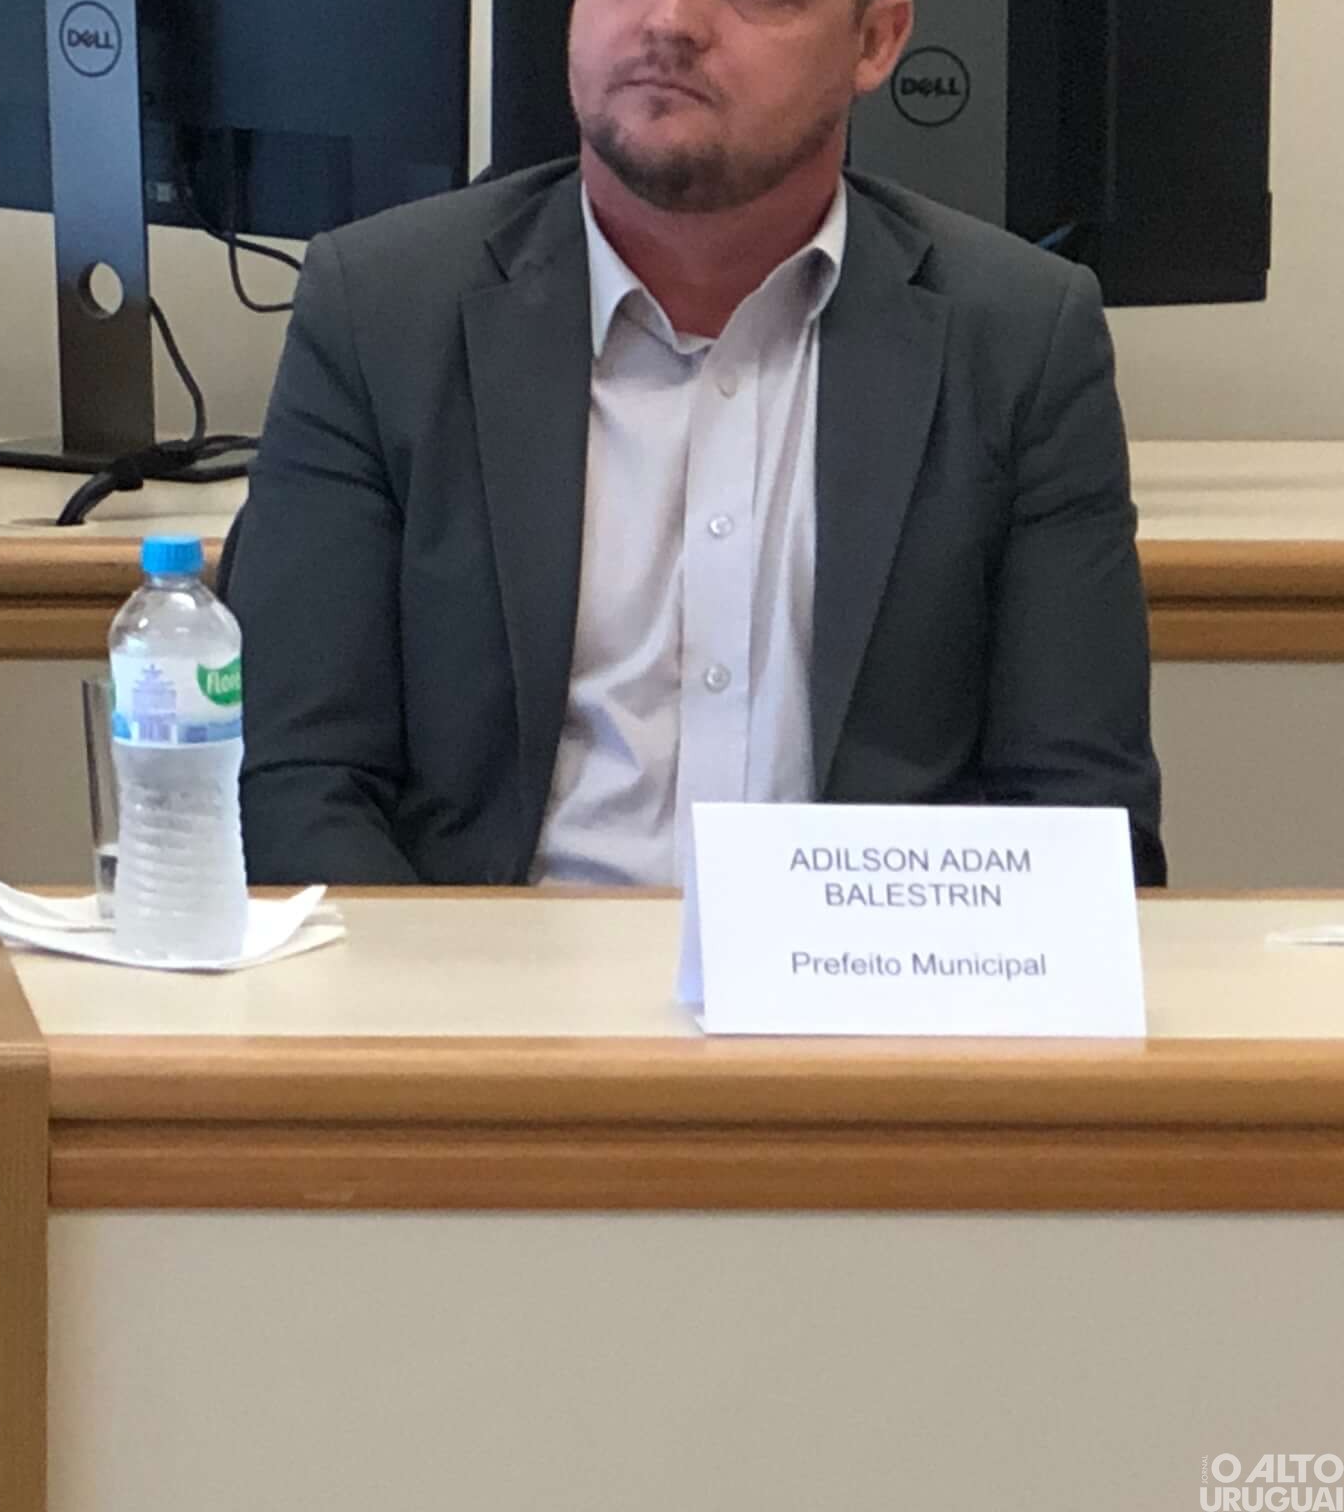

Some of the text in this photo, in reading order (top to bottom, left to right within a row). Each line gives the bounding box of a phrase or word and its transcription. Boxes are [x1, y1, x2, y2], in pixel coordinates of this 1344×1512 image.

[67, 28, 114, 50] DELL
[900, 76, 961, 98] DELL
[789, 847, 1032, 873] ADILSON ADAM
[824, 882, 1003, 907] BALESTRIN
[791, 951, 1047, 981] Prefeito Municipal
